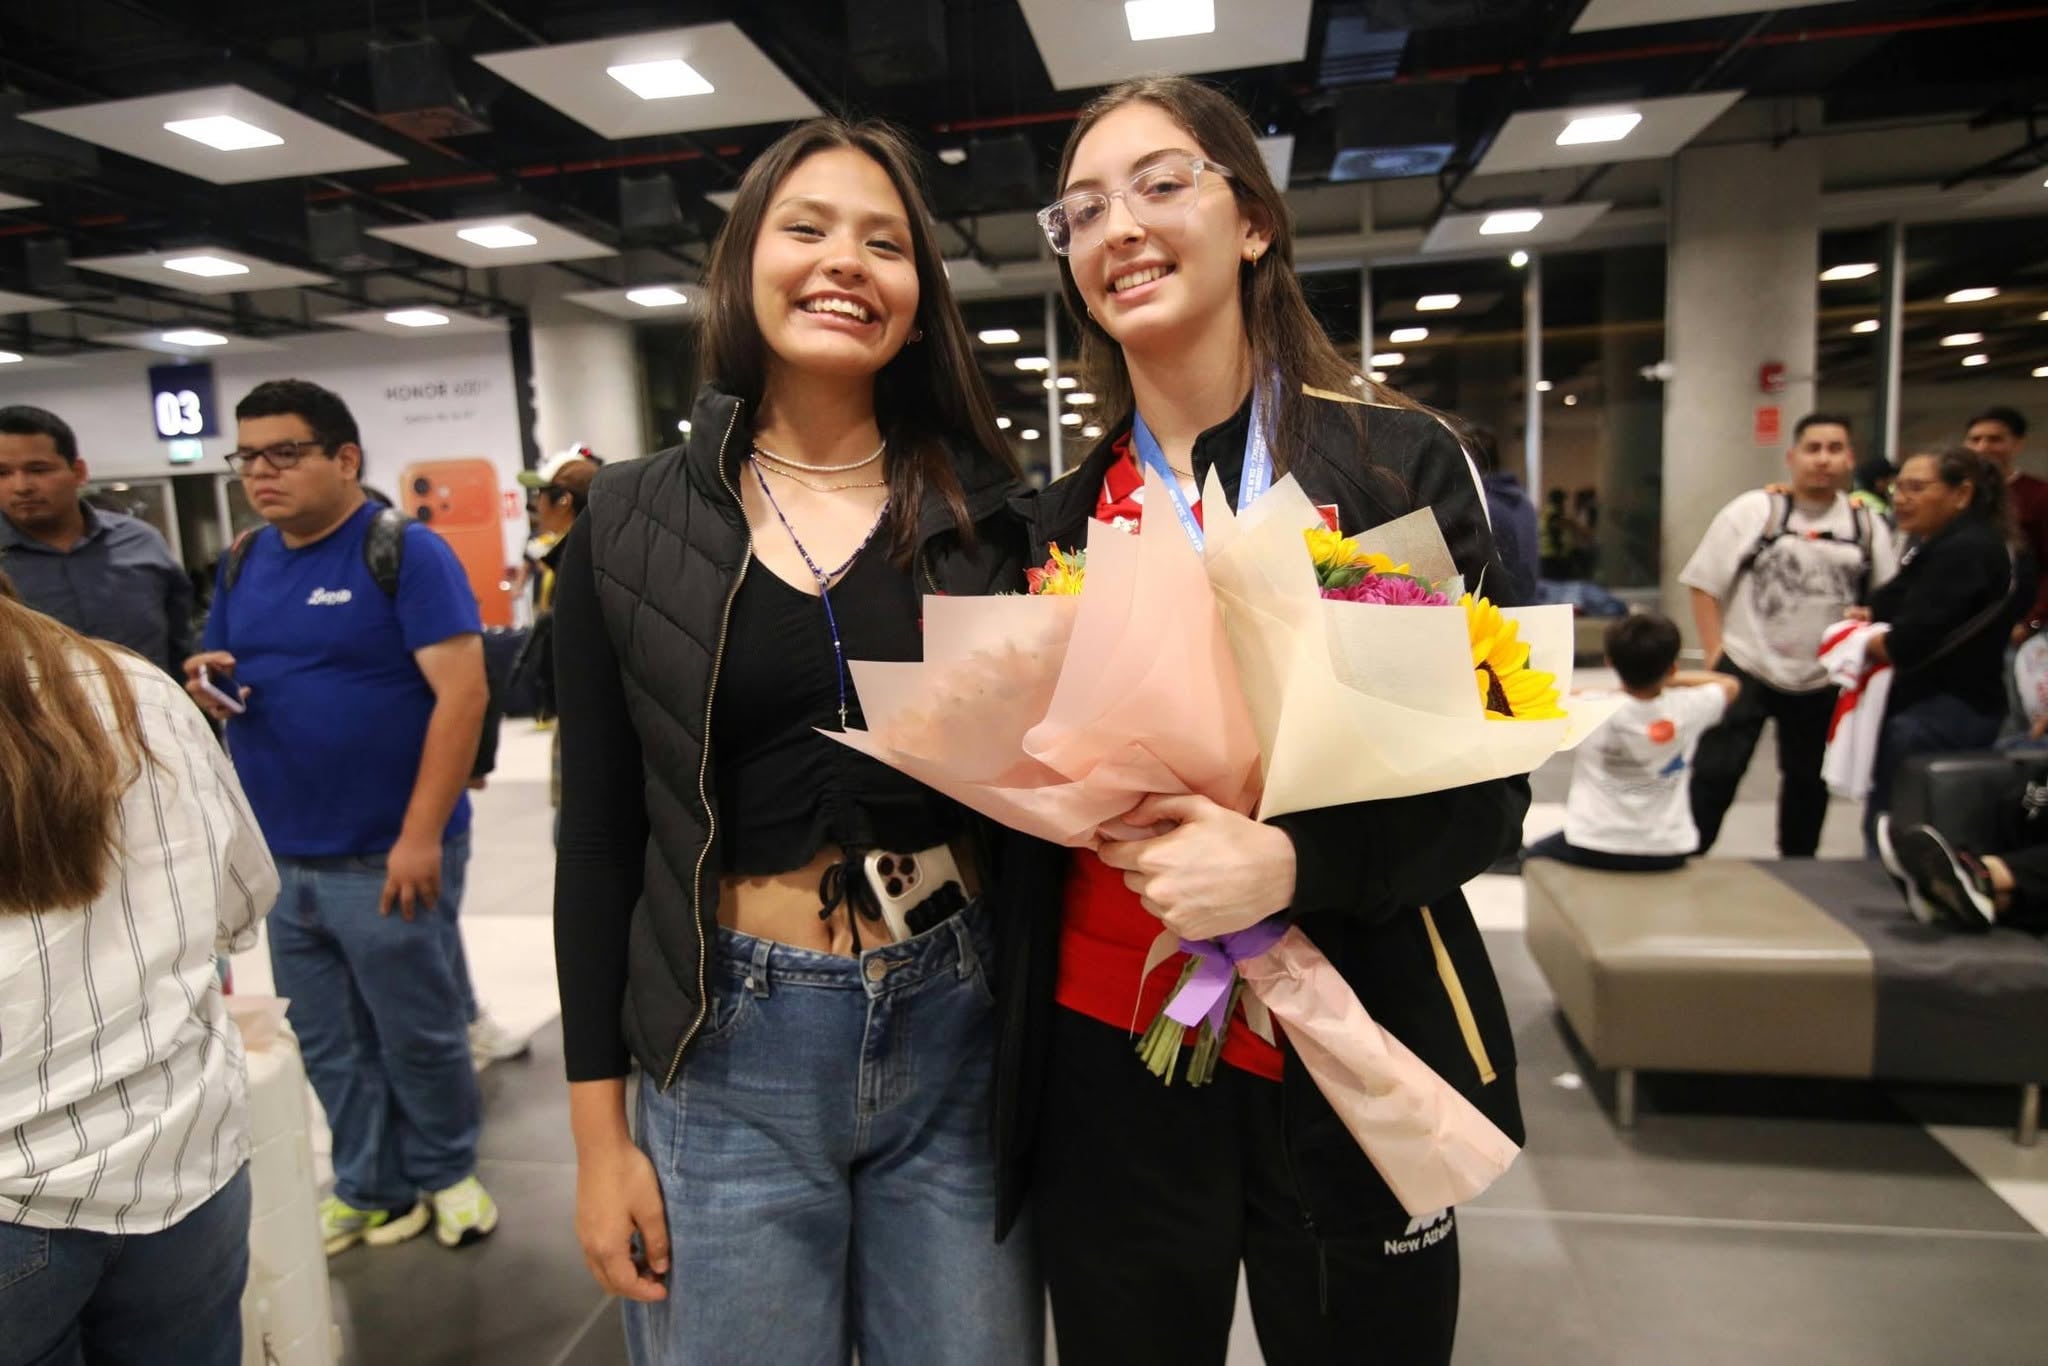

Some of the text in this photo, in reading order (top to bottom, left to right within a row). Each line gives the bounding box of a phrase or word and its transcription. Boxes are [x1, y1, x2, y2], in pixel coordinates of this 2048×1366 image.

[385, 382, 448, 400] HONOR
[155, 390, 204, 436] 03
[1384, 1237, 1420, 1255] New
